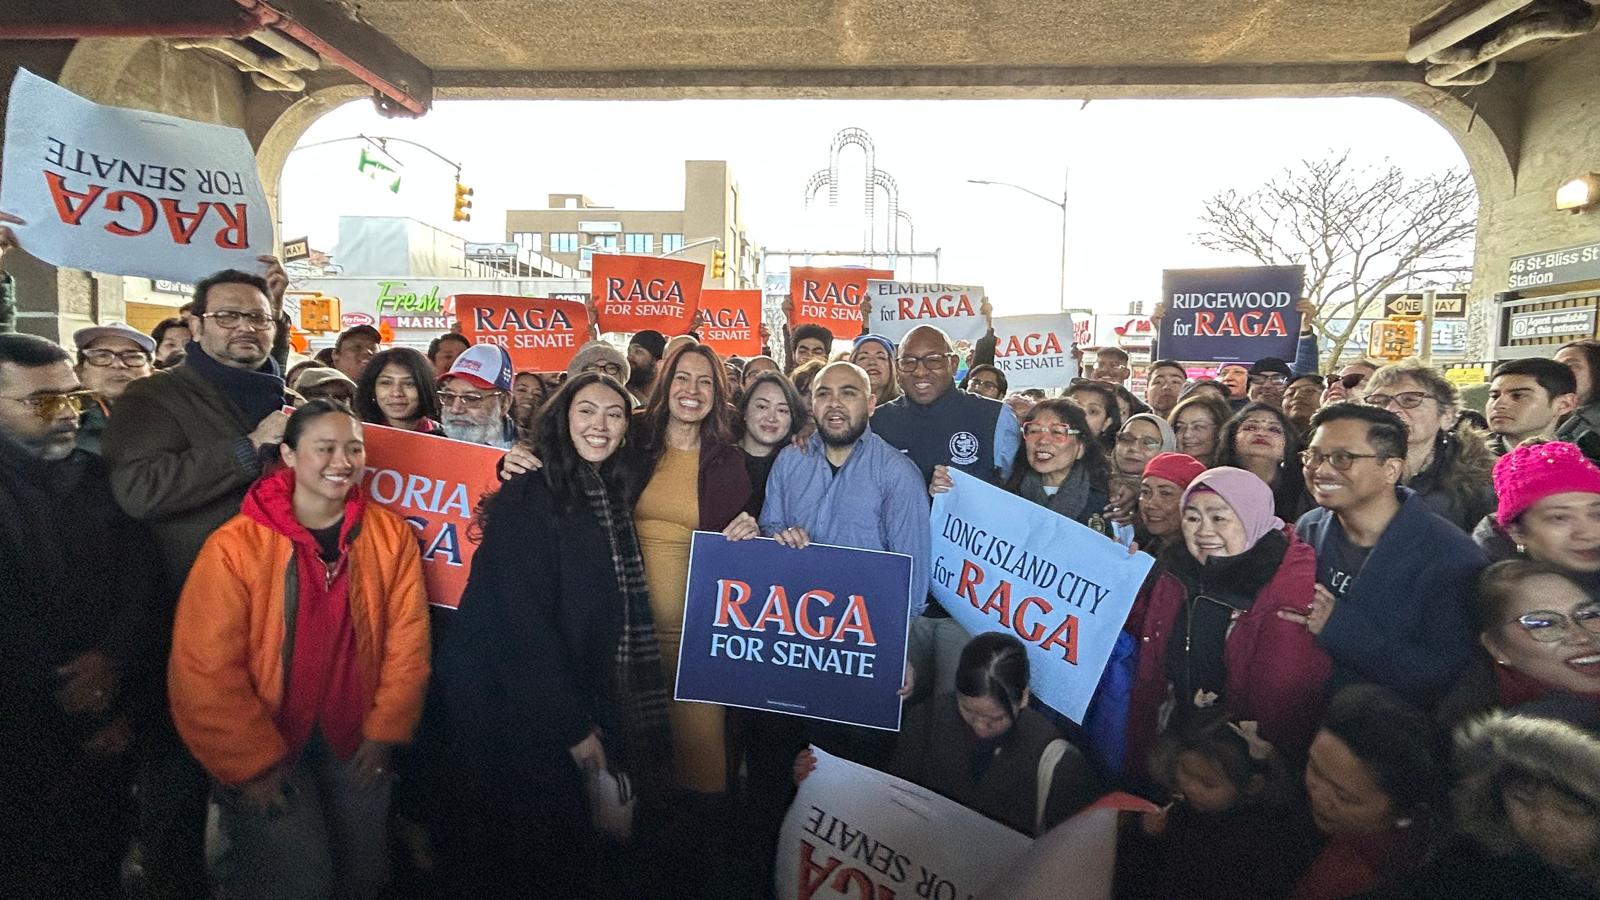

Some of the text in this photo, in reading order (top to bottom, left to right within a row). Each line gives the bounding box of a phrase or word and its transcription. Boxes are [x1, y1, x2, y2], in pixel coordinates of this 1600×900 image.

[45, 136, 245, 196] FOR SENATE
[43, 170, 249, 250] RAGA
[1510, 247, 1599, 273] 46 St-Bliss St
[606, 277, 685, 305] RAGA
[1508, 272, 1553, 288] Station
[376, 281, 441, 313] Fresh
[802, 280, 868, 307] RAG
[1173, 292, 1290, 308] RIDGEWOOD
[1396, 301, 1419, 311] ONE
[473, 308, 574, 332] RAGA
[604, 304, 685, 319] FOR SENATE
[701, 308, 750, 329] AGA
[801, 305, 864, 321] FOR SENA
[880, 295, 975, 321] for RAGA
[396, 316, 458, 328] MARKE
[708, 330, 750, 340] SENATE
[1173, 318, 1191, 336] for
[1194, 311, 1288, 337] RAGA
[514, 333, 575, 348] SENATE
[1015, 356, 1065, 370] SENATE
[365, 466, 471, 519] ORIA
[942, 513, 1110, 615] LONG ISLAND CITY
[712, 579, 877, 647] RAGA
[933, 556, 1080, 666] for RAGA
[710, 633, 876, 678] FOR SENATE
[802, 805, 911, 883] SENATE
